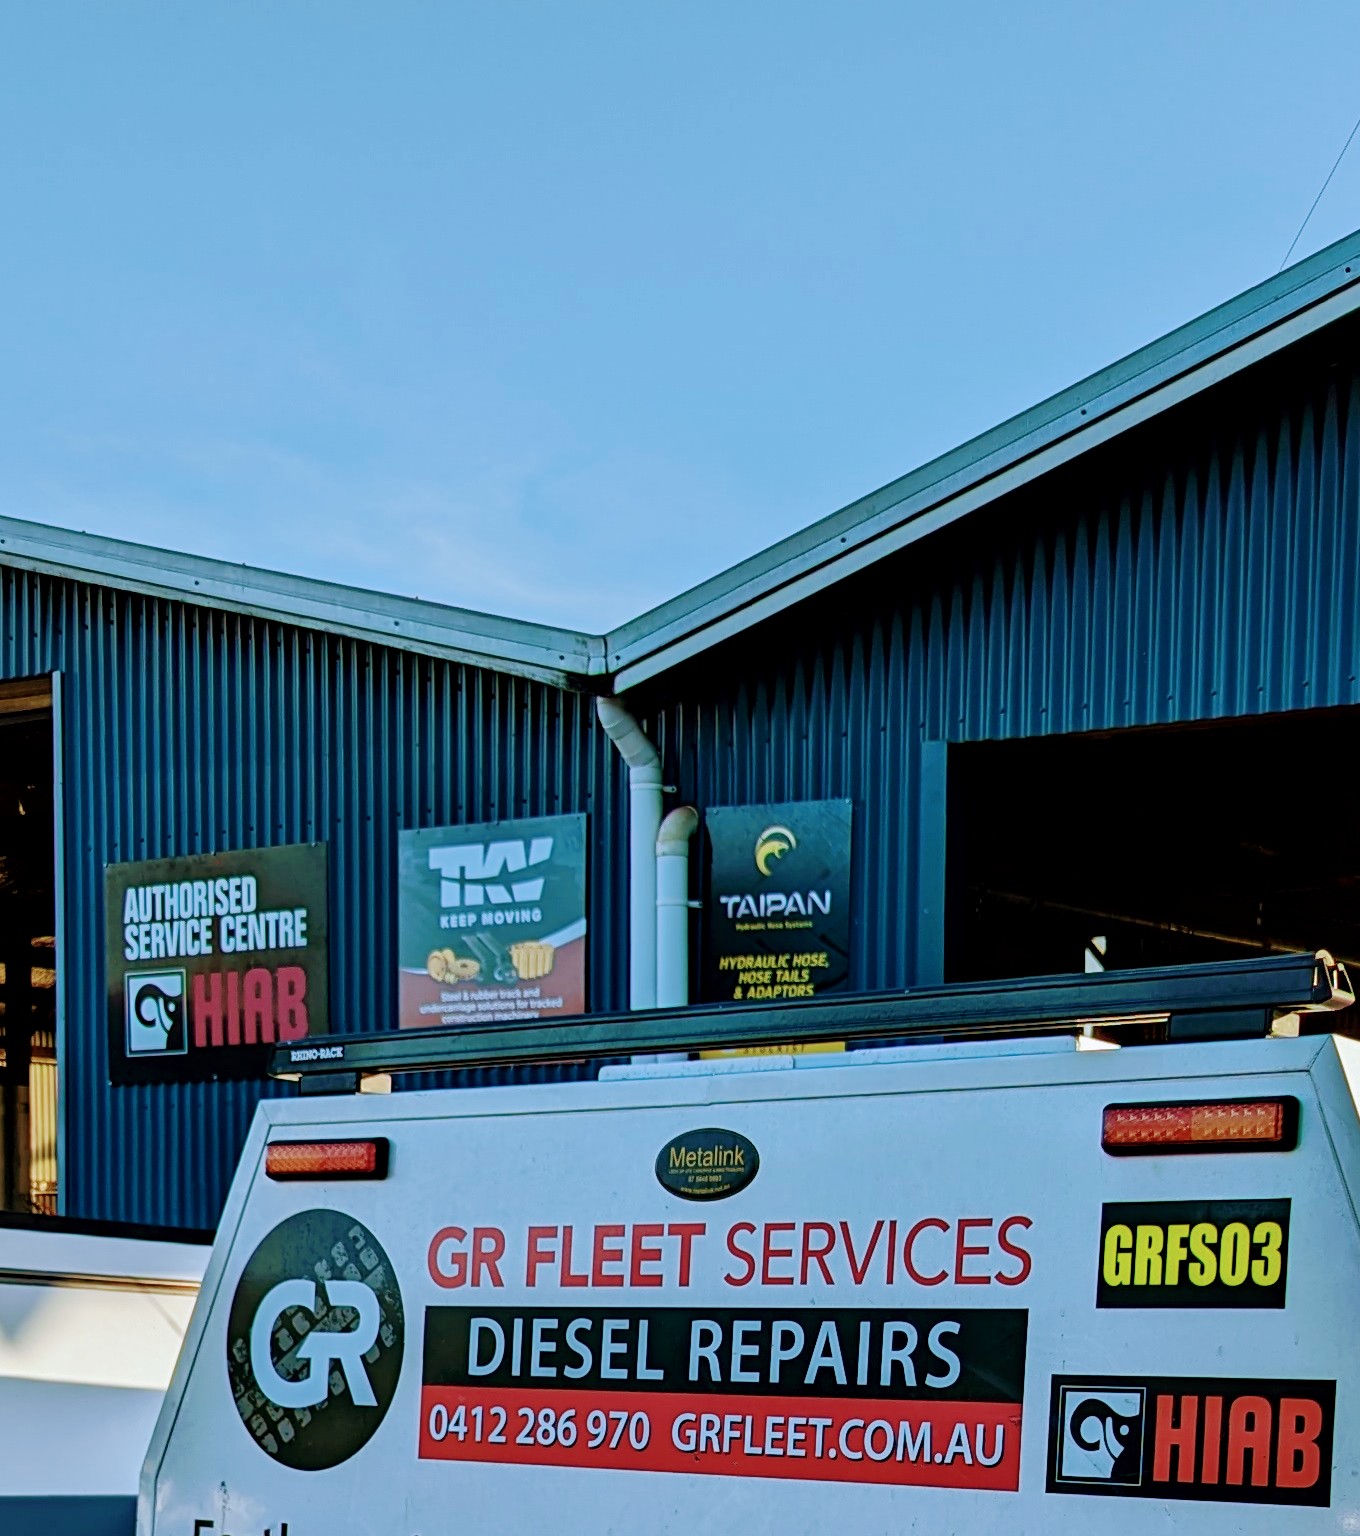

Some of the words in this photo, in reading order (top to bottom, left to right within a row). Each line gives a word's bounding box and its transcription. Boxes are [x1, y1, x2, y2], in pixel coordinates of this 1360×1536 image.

[124, 876, 256, 924] AUTHORISED
[441, 912, 477, 928] KEEP
[481, 908, 541, 925] MOVING
[719, 890, 831, 918] TAIPAN
[124, 919, 212, 961] SERVICE
[221, 909, 307, 953] CENTRE
[719, 954, 790, 970] HYDRAULIC
[792, 952, 829, 968] HOSE,
[738, 971, 772, 984] HOSE
[776, 970, 809, 982] TAILS
[193, 966, 309, 1047] HIAB
[733, 986, 742, 999] &
[747, 984, 814, 999] ADAPTORS
[291, 1046, 344, 1062] RHINO-RACK
[669, 1145, 744, 1167] Metalink
[427, 1227, 505, 1289] GR
[527, 1222, 707, 1289] FLEET
[724, 1216, 1034, 1288] SERVICES
[1102, 1220, 1284, 1289] GRFS03
[252, 1278, 381, 1408] GR
[468, 1317, 665, 1382] DIESEL
[689, 1320, 961, 1388] REPAIRS
[428, 1405, 509, 1444] 0412
[514, 1408, 582, 1449] 286
[586, 1411, 651, 1452] 970
[670, 1415, 1006, 1468] GRFLEET.COM.AU
[1154, 1394, 1322, 1490] HIAB
